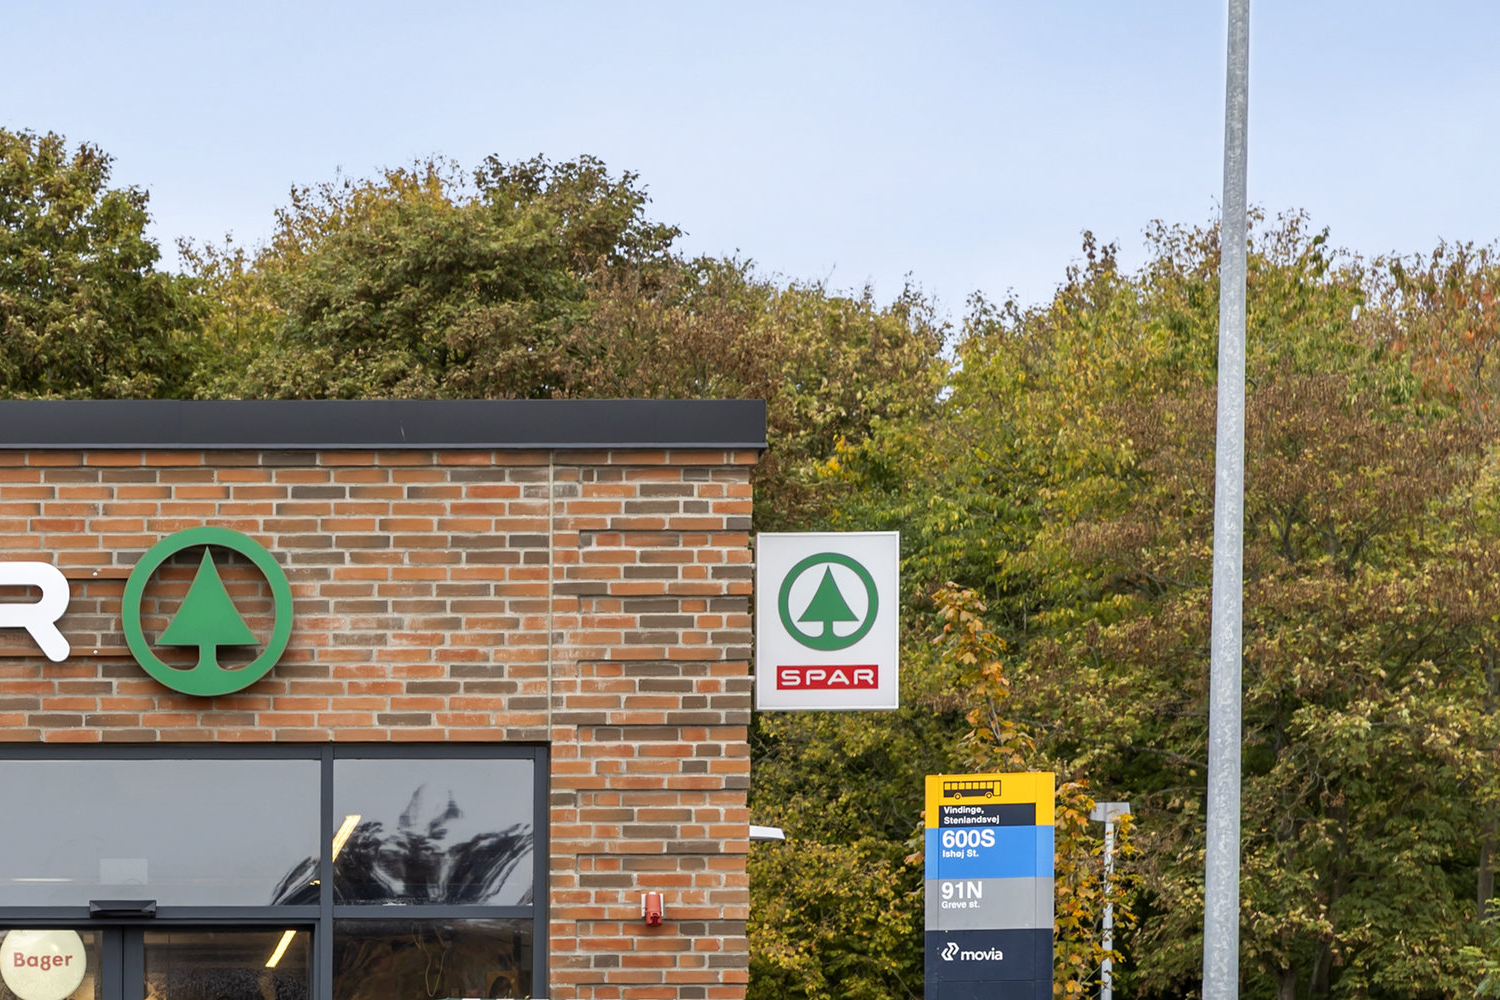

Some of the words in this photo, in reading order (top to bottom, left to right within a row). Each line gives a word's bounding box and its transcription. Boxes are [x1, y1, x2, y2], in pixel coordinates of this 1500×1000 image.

[781, 668, 874, 686] SPAR
[943, 806, 985, 815] Vindinge,
[943, 814, 1000, 825] Stenlandsvej
[942, 829, 996, 848] 600S
[942, 849, 964, 859] Ishøj
[966, 849, 979, 858] St.
[941, 881, 982, 899] 91N
[941, 900, 967, 909] Greve
[969, 900, 980, 908] st.
[960, 947, 1003, 961] movia
[13, 952, 73, 971] Bager
